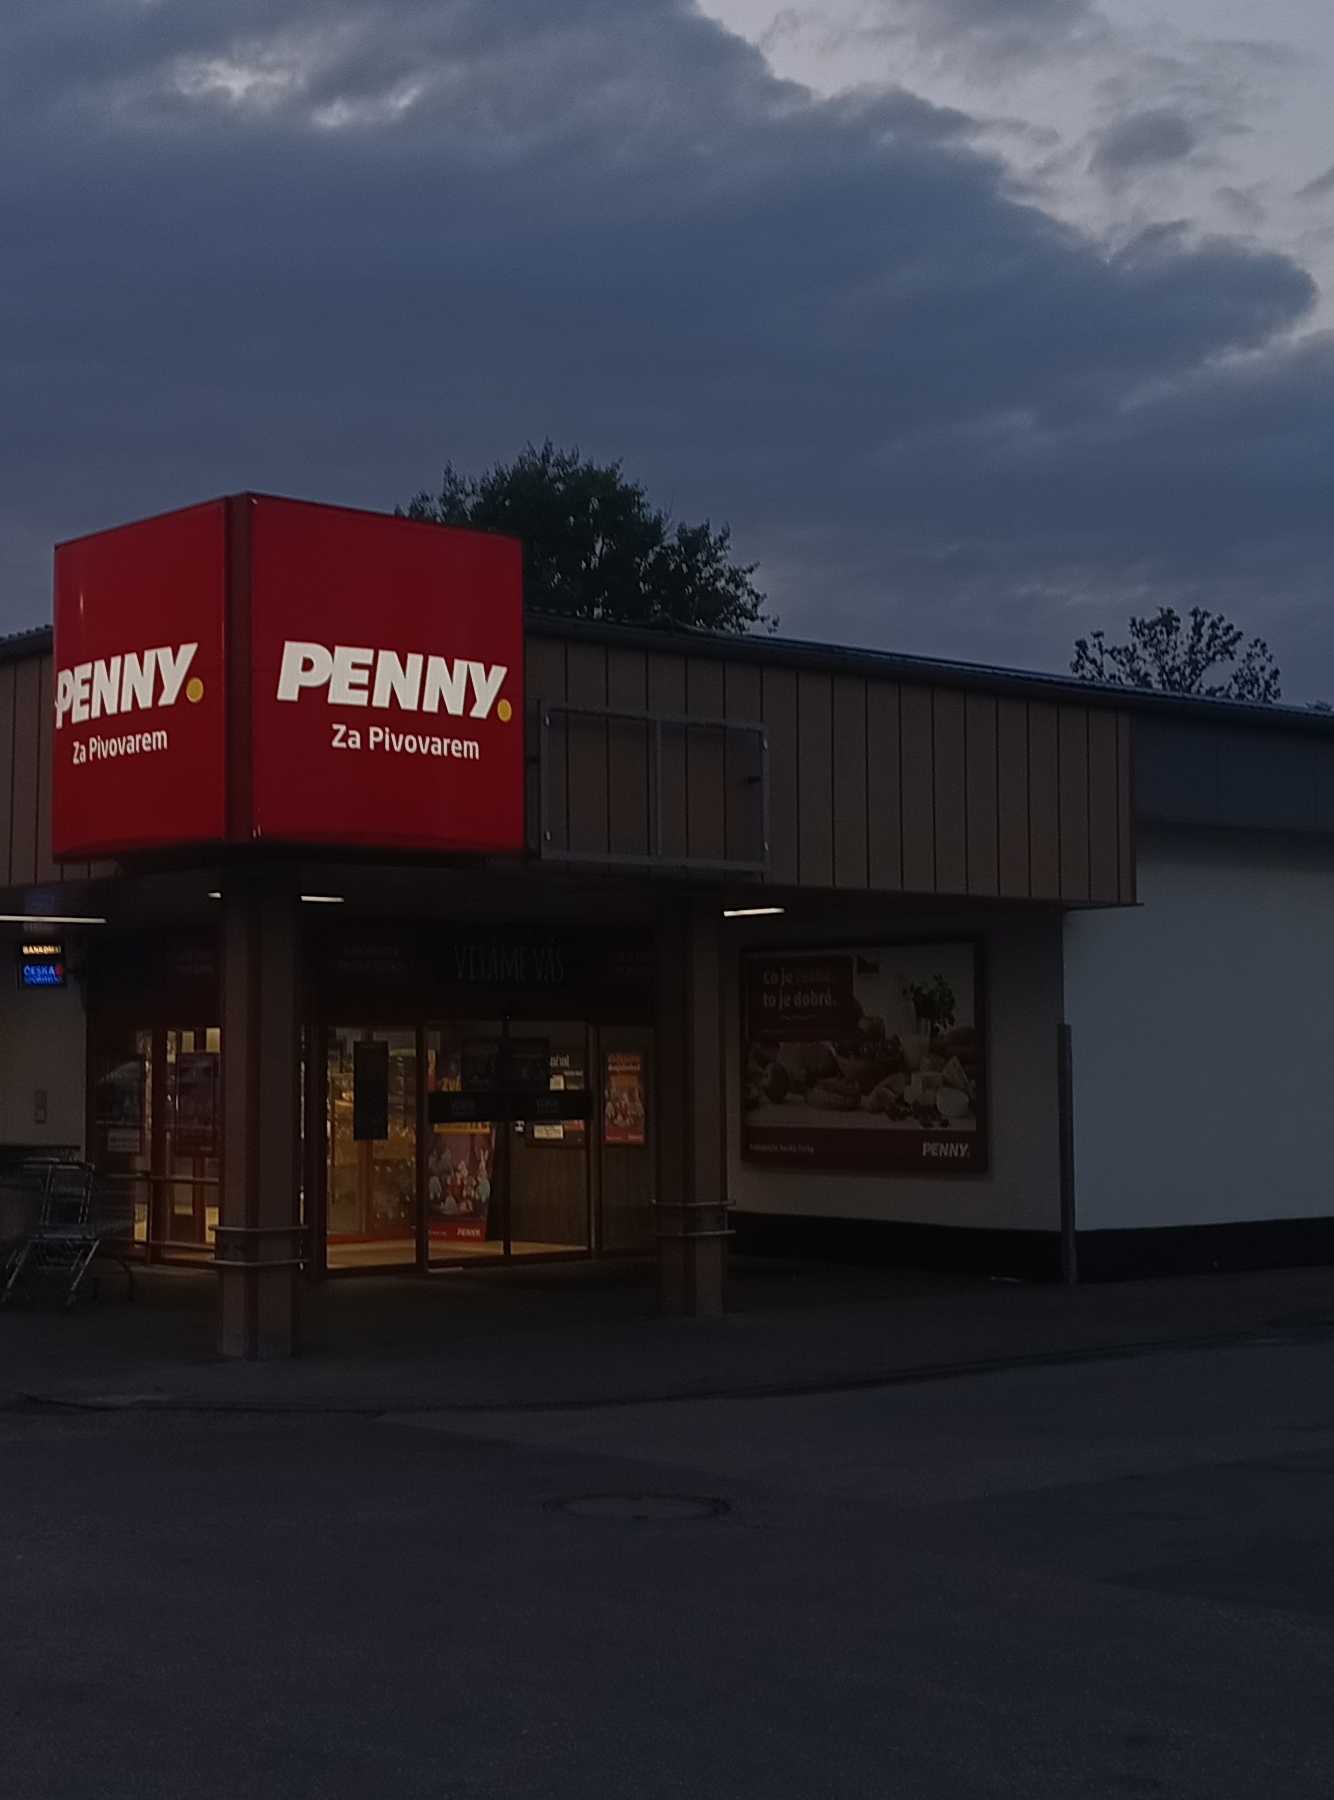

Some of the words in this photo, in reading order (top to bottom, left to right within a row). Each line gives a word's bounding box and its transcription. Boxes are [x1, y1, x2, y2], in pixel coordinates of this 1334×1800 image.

[277, 640, 513, 724] PENNY.
[71, 738, 88, 765] Za
[88, 728, 169, 759] Pivovarem
[331, 722, 361, 751] Za
[368, 727, 482, 761] Pivovarem
[763, 969, 779, 985] Co
[779, 966, 793, 987] je
[763, 992, 777, 1008] to
[777, 989, 791, 1010] je
